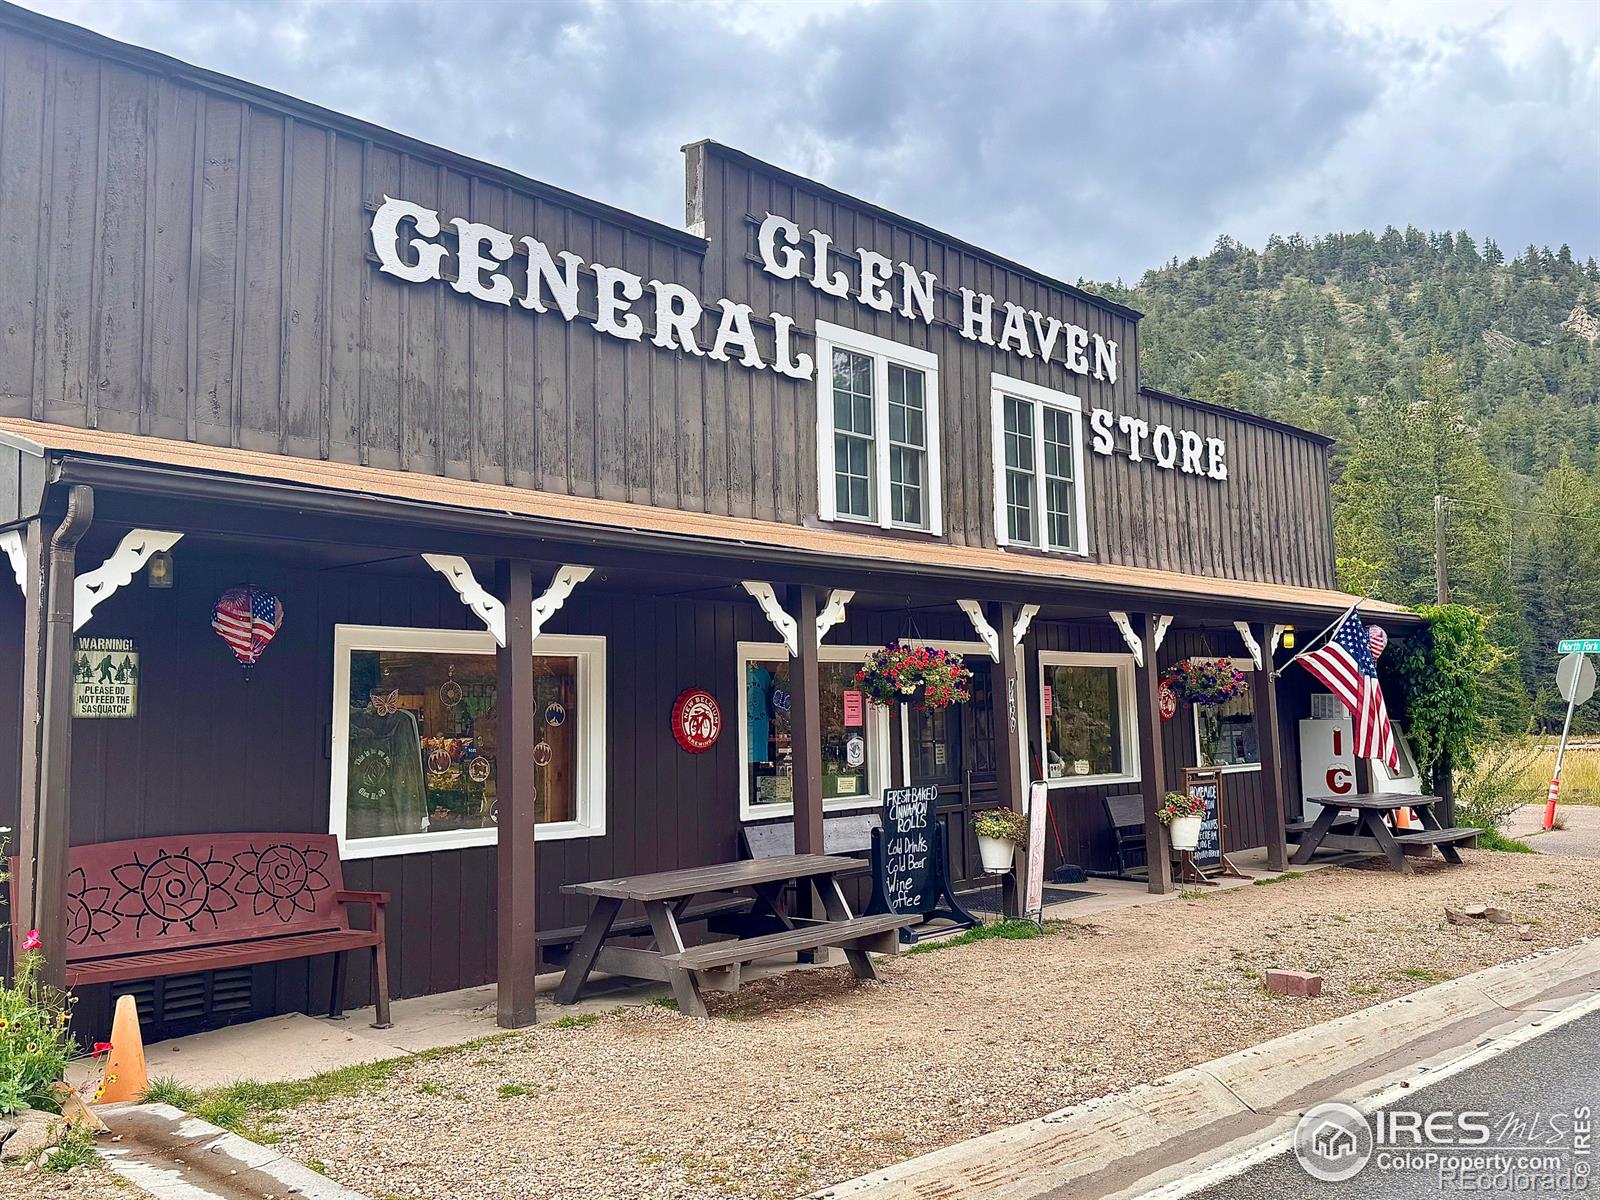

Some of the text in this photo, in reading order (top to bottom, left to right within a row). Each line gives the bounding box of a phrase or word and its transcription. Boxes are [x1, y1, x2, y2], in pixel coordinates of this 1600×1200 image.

[369, 193, 814, 382] GENERAL
[757, 211, 1118, 385] GLEN HAVEN
[1090, 407, 1228, 482] STORE
[79, 637, 133, 650] WARNING!
[1562, 641, 1598, 651] North Fork
[79, 695, 130, 704] NOT FEED THE
[85, 686, 125, 695] PLEASE DO
[81, 704, 127, 714] SASQUATCH
[684, 697, 719, 724] NEW BELGIUM
[1325, 725, 1354, 797] IC
[887, 785, 938, 807] FRESH BAKED
[889, 801, 928, 821] CINNAMON
[897, 813, 927, 833] ROLLS
[887, 833, 928, 856] Cold Drinks
[886, 854, 927, 874] Cold Beer
[886, 872, 913, 894] Wine
[888, 890, 921, 909] offee
